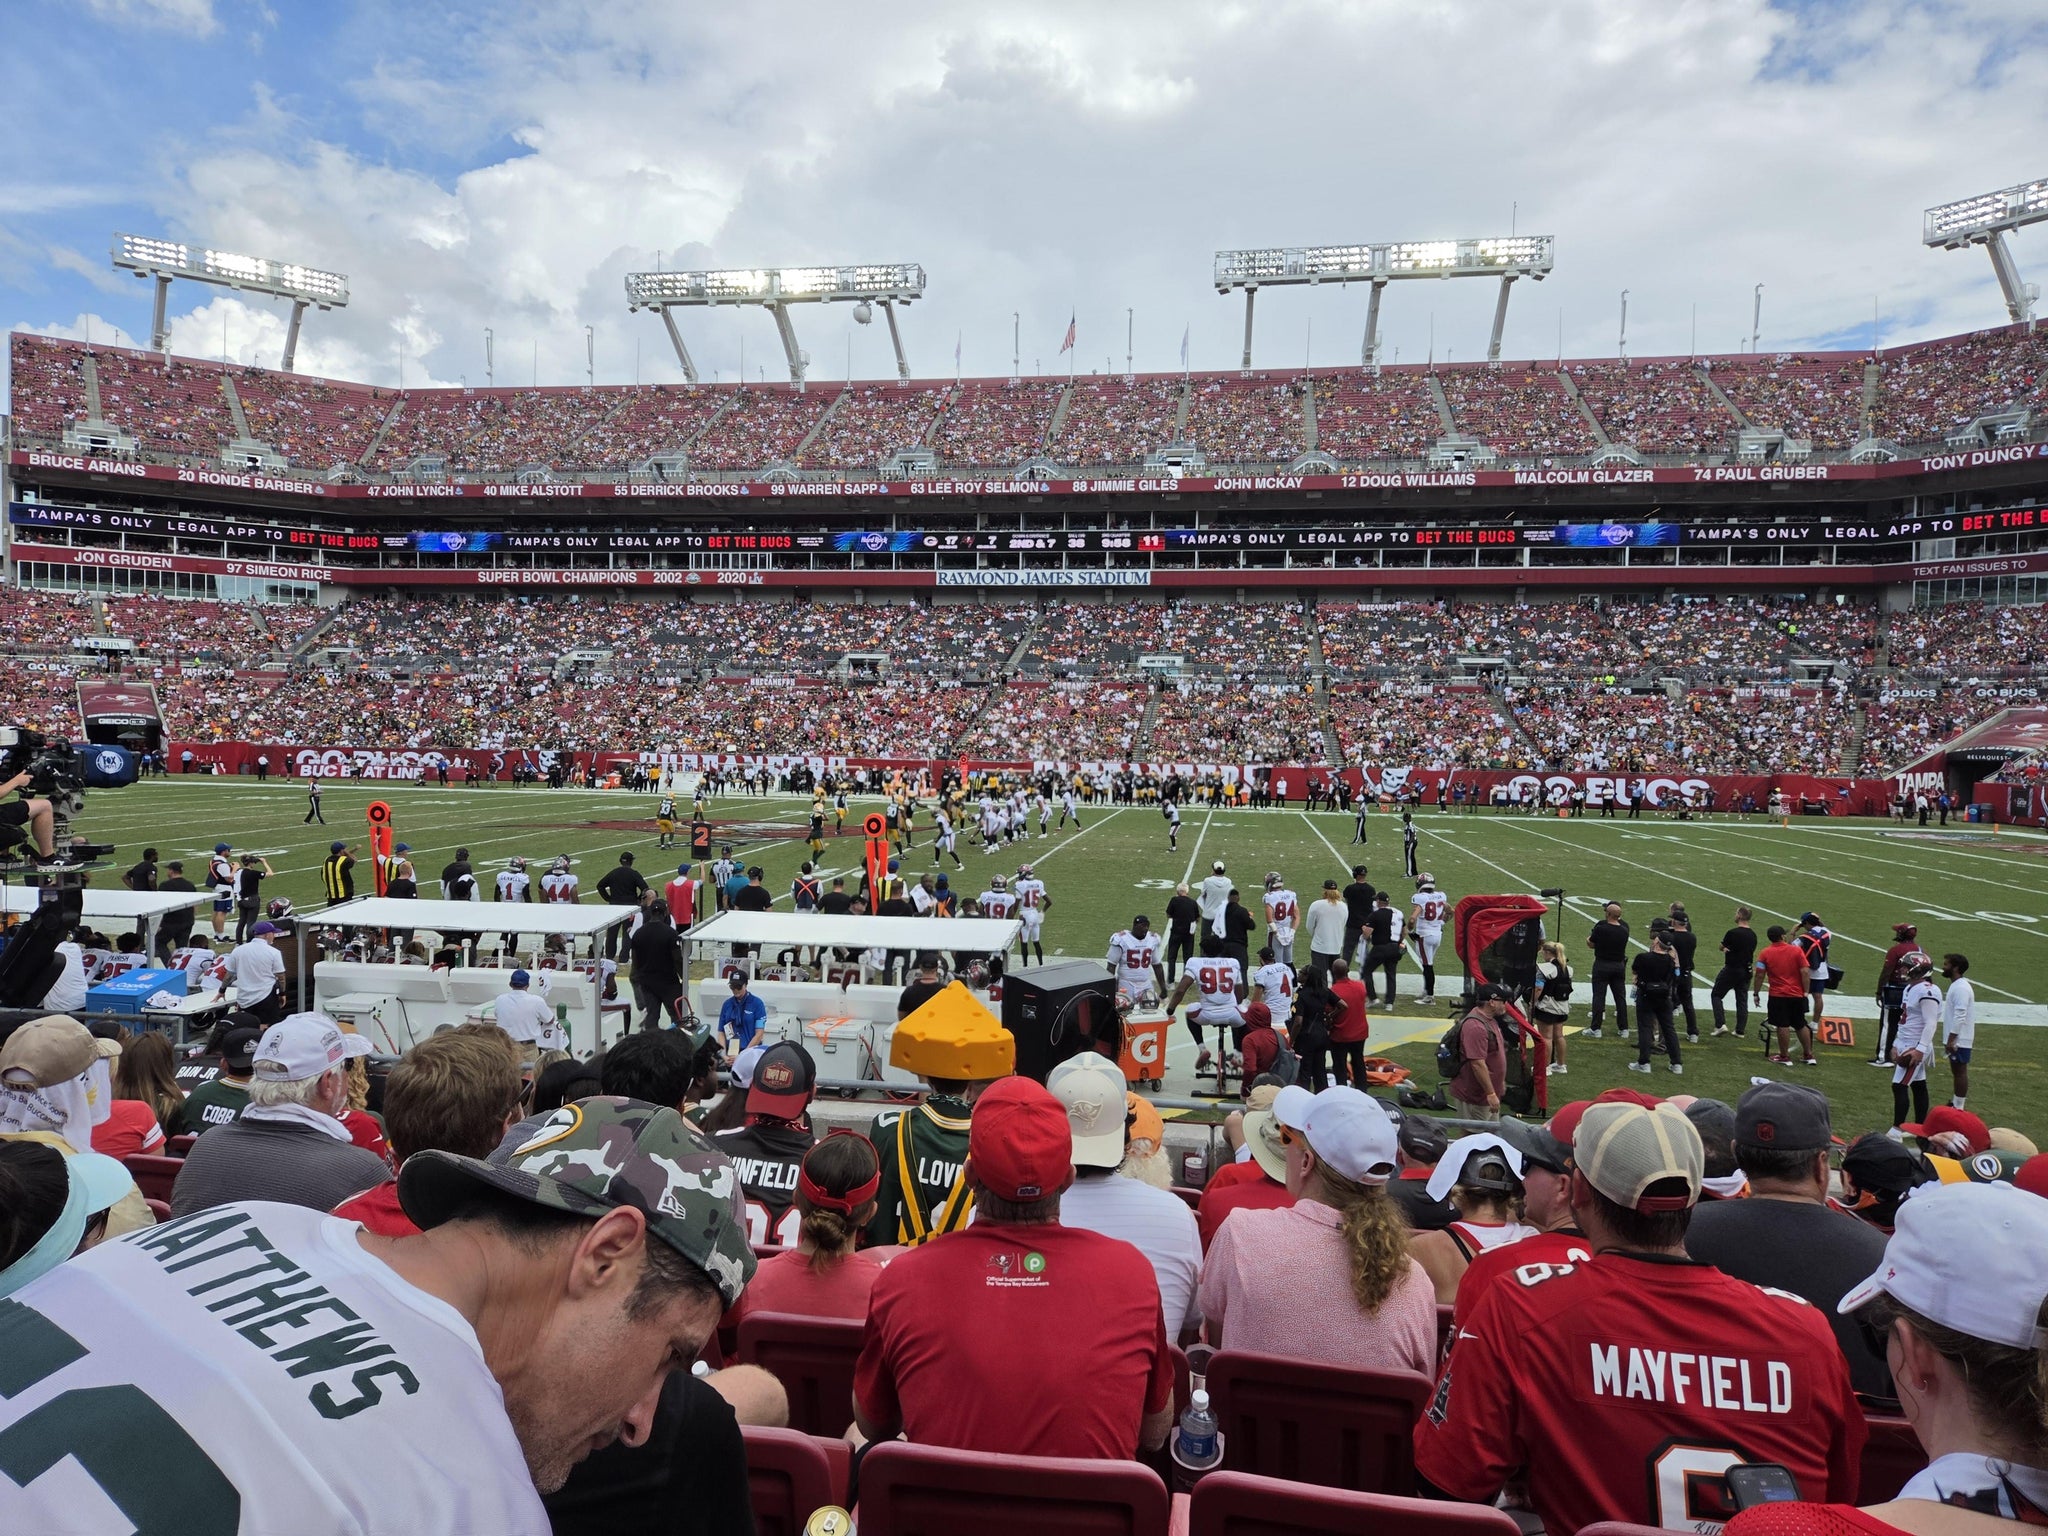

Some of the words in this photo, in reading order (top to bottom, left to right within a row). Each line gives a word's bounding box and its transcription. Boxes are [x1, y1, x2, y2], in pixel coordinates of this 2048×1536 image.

[29, 453, 86, 471] BRUCE
[88, 459, 146, 477] ARIANS
[1921, 454, 1969, 471] TONY
[1970, 445, 2036, 466] DUNGY
[1341, 477, 1357, 488] 12
[1359, 475, 1402, 487] DOUG
[1405, 473, 1476, 486] WILLIAMS
[1514, 471, 1591, 484] MALCOLM
[1593, 470, 1654, 483] GLAZER
[1694, 469, 1712, 481] 74
[1715, 468, 1756, 480] PAUL
[1759, 466, 1828, 480] GRUBER
[178, 469, 195, 482] 20
[253, 477, 313, 494] BARBER
[910, 483, 926, 494] 63
[928, 483, 953, 494] LEE
[954, 482, 982, 494] ROY
[985, 482, 1039, 493] SELMON
[1072, 482, 1087, 493] 88
[1090, 480, 1136, 492] JIMMIE
[1138, 479, 1178, 491] GILES
[1214, 478, 1247, 490] JOHN
[1249, 477, 1304, 489] MCKAY
[368, 486, 381, 496] 47
[383, 486, 413, 496] JOHN
[415, 486, 454, 496] LYNCH
[483, 486, 498, 496] 40
[500, 486, 529, 496] MIKE
[530, 485, 584, 496] ALSTOTT
[614, 485, 629, 496] 55
[630, 485, 685, 496] DERRICK
[686, 485, 739, 496] BROOKS
[771, 484, 785, 495] 99
[787, 484, 842, 495] WARREN
[843, 484, 878, 495] SAPP
[28, 509, 102, 525] TAMPA'S
[110, 516, 152, 529] ONLY
[167, 521, 219, 535] LEGAL
[226, 526, 257, 538] APP
[264, 529, 283, 541] TO
[290, 531, 315, 544] BET
[319, 533, 344, 546] THE
[348, 534, 379, 548] BUCS
[1689, 528, 1758, 540] TAMPA'S
[1766, 527, 1810, 539] ONLY
[1825, 526, 1879, 538] LEGAL
[1888, 523, 1922, 536] APP
[1931, 520, 1953, 532] TO
[1962, 514, 1994, 531] BET
[2000, 511, 2034, 527] THE
[508, 537, 561, 547] TAMPA'S
[566, 537, 599, 547] ONLY
[609, 537, 650, 547] LEGAL
[655, 536, 681, 547] APP
[686, 536, 703, 546] TO
[708, 536, 732, 548] BET
[734, 536, 757, 548] THE
[760, 536, 792, 548] BUCS
[944, 535, 958, 545] 17
[988, 535, 997, 545] 7
[1009, 539, 1035, 548] 2ND
[1035, 539, 1046, 548] &
[1047, 539, 1056, 548] 7
[1143, 535, 1159, 546] 11
[1180, 533, 1241, 544] TAMPA'S
[1248, 533, 1286, 544] ONLY
[1299, 533, 1346, 544] LEGAL
[1353, 532, 1383, 543] APP
[1390, 532, 1409, 543] TO
[1416, 531, 1443, 544] BET
[1448, 530, 1473, 543] THE
[1478, 530, 1516, 543] BUCS
[74, 551, 105, 565] JON
[108, 553, 172, 568] GRUDEN
[226, 562, 244, 574] 97
[245, 564, 298, 579] SIMEON
[300, 568, 332, 581] RICE
[1913, 566, 1940, 576] TEXT
[1942, 564, 1964, 574] FAN
[1967, 561, 2009, 573] ISSUES
[2011, 560, 2028, 569] TO
[478, 572, 520, 583] SUPER
[522, 572, 560, 583] BOWL
[562, 572, 637, 584] CHAMPIONS
[653, 572, 683, 584] 2002
[716, 572, 747, 584] 2020
[938, 571, 1019, 586] RAYMOND
[1020, 571, 1074, 587] JAMES
[1077, 570, 1149, 585] STADIUM
[1902, 689, 1937, 698] BUCS
[1976, 689, 1998, 698] GO
[2002, 688, 2038, 698] BUCS
[103, 756, 116, 765] FOX
[300, 764, 342, 777] BUC
[344, 765, 386, 778] BAT
[1895, 772, 1945, 794] TAMPA
[1587, 778, 1710, 812] BUCS
[660, 803, 671, 815] 33
[694, 827, 708, 846] 2
[505, 883, 513, 901] 1
[547, 883, 570, 901] 44
[985, 902, 1006, 919] 19
[1274, 902, 1295, 921] 84
[168, 954, 193, 970] 51
[1199, 967, 1234, 994] 95
[1280, 974, 1292, 998] 4
[1825, 1020, 1851, 1044] 20
[1131, 1032, 1158, 1063] G
[175, 1065, 199, 1079] BAIN
[199, 1066, 220, 1080] JR
[202, 1104, 237, 1125] COBB
[1590, 1342, 1792, 1414] MAYFIELD
